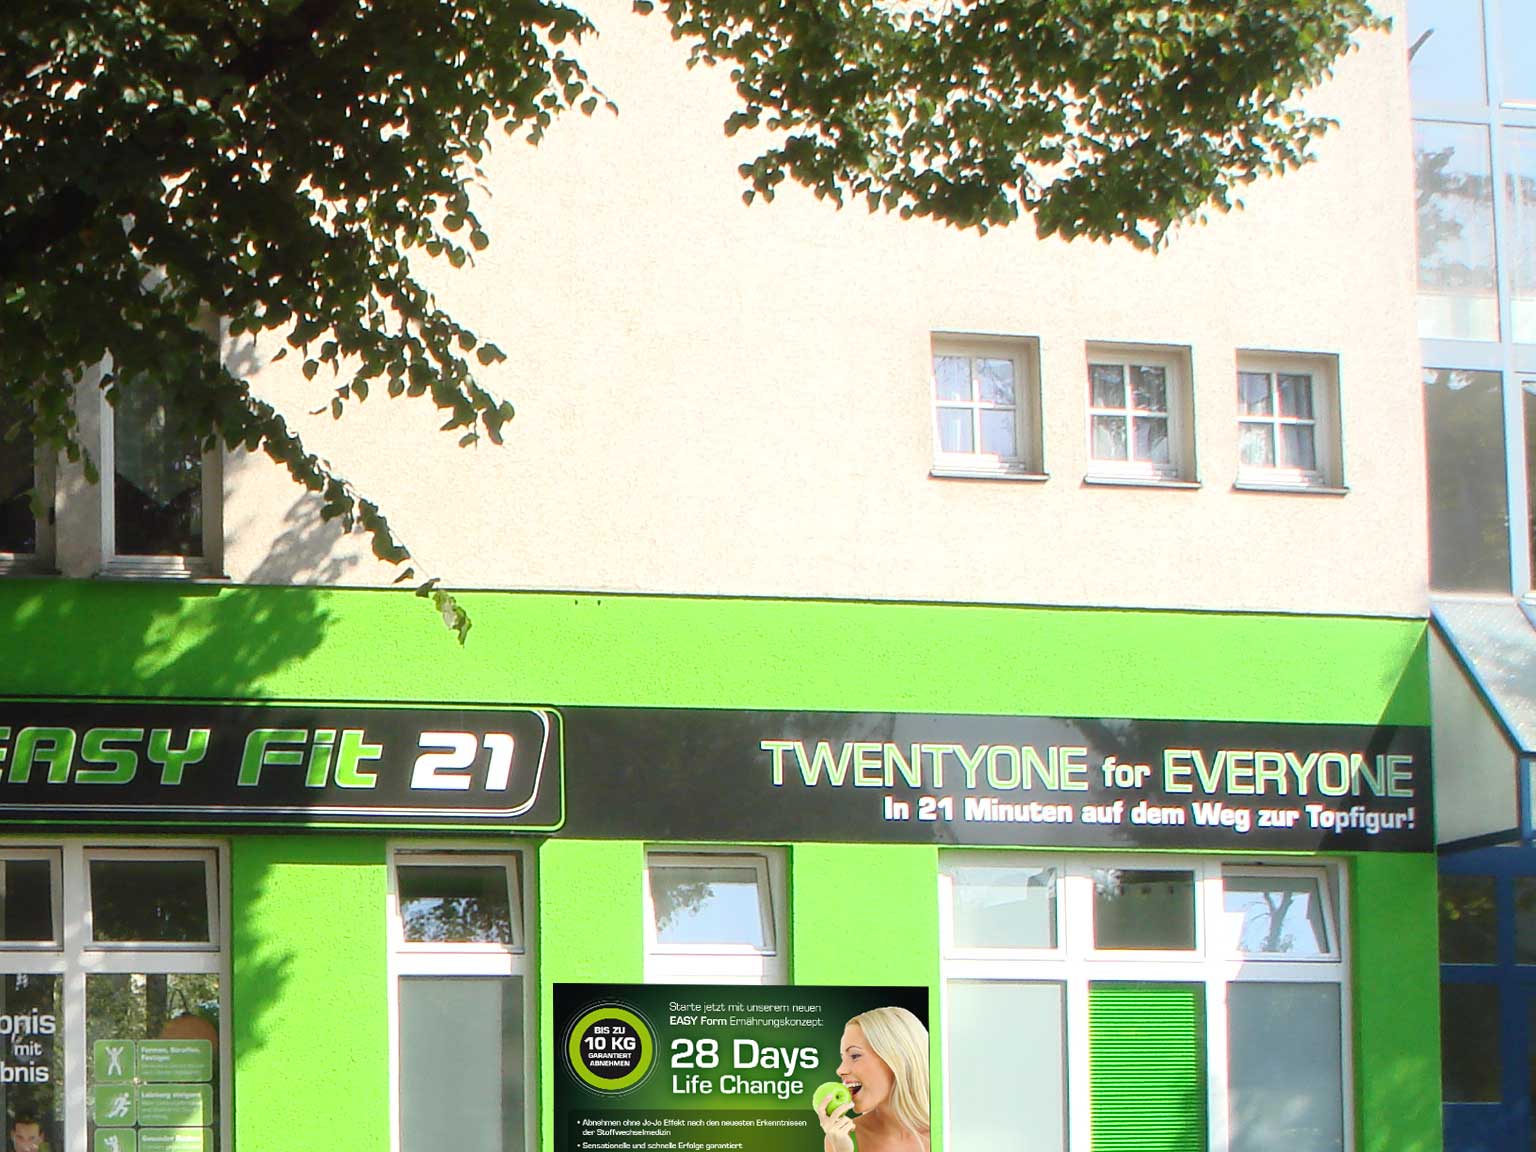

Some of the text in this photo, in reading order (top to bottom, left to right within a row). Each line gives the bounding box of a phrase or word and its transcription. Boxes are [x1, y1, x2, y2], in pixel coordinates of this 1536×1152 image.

[237, 729, 383, 788] Fit
[409, 731, 514, 791] 21
[760, 740, 1414, 798] TWENTYONE for EVERYONE
[883, 795, 1415, 834] In 21 Minuten auf dem Weg zur Topfigur!
[669, 1002, 822, 1014] Starte jetzt mit unserem neuen
[669, 1016, 824, 1028] EASY Form Ernährungskonzept:
[594, 1026, 626, 1035] BIS ZU
[14, 1041, 42, 1056] mit
[584, 1036, 636, 1051] 10 KG
[671, 1038, 819, 1077] 28 Days
[672, 1075, 804, 1100] Life Change
[663, 1119, 685, 1127] Effekt
[706, 1119, 720, 1127] den
[678, 1142, 704, 1150] Erfolge
